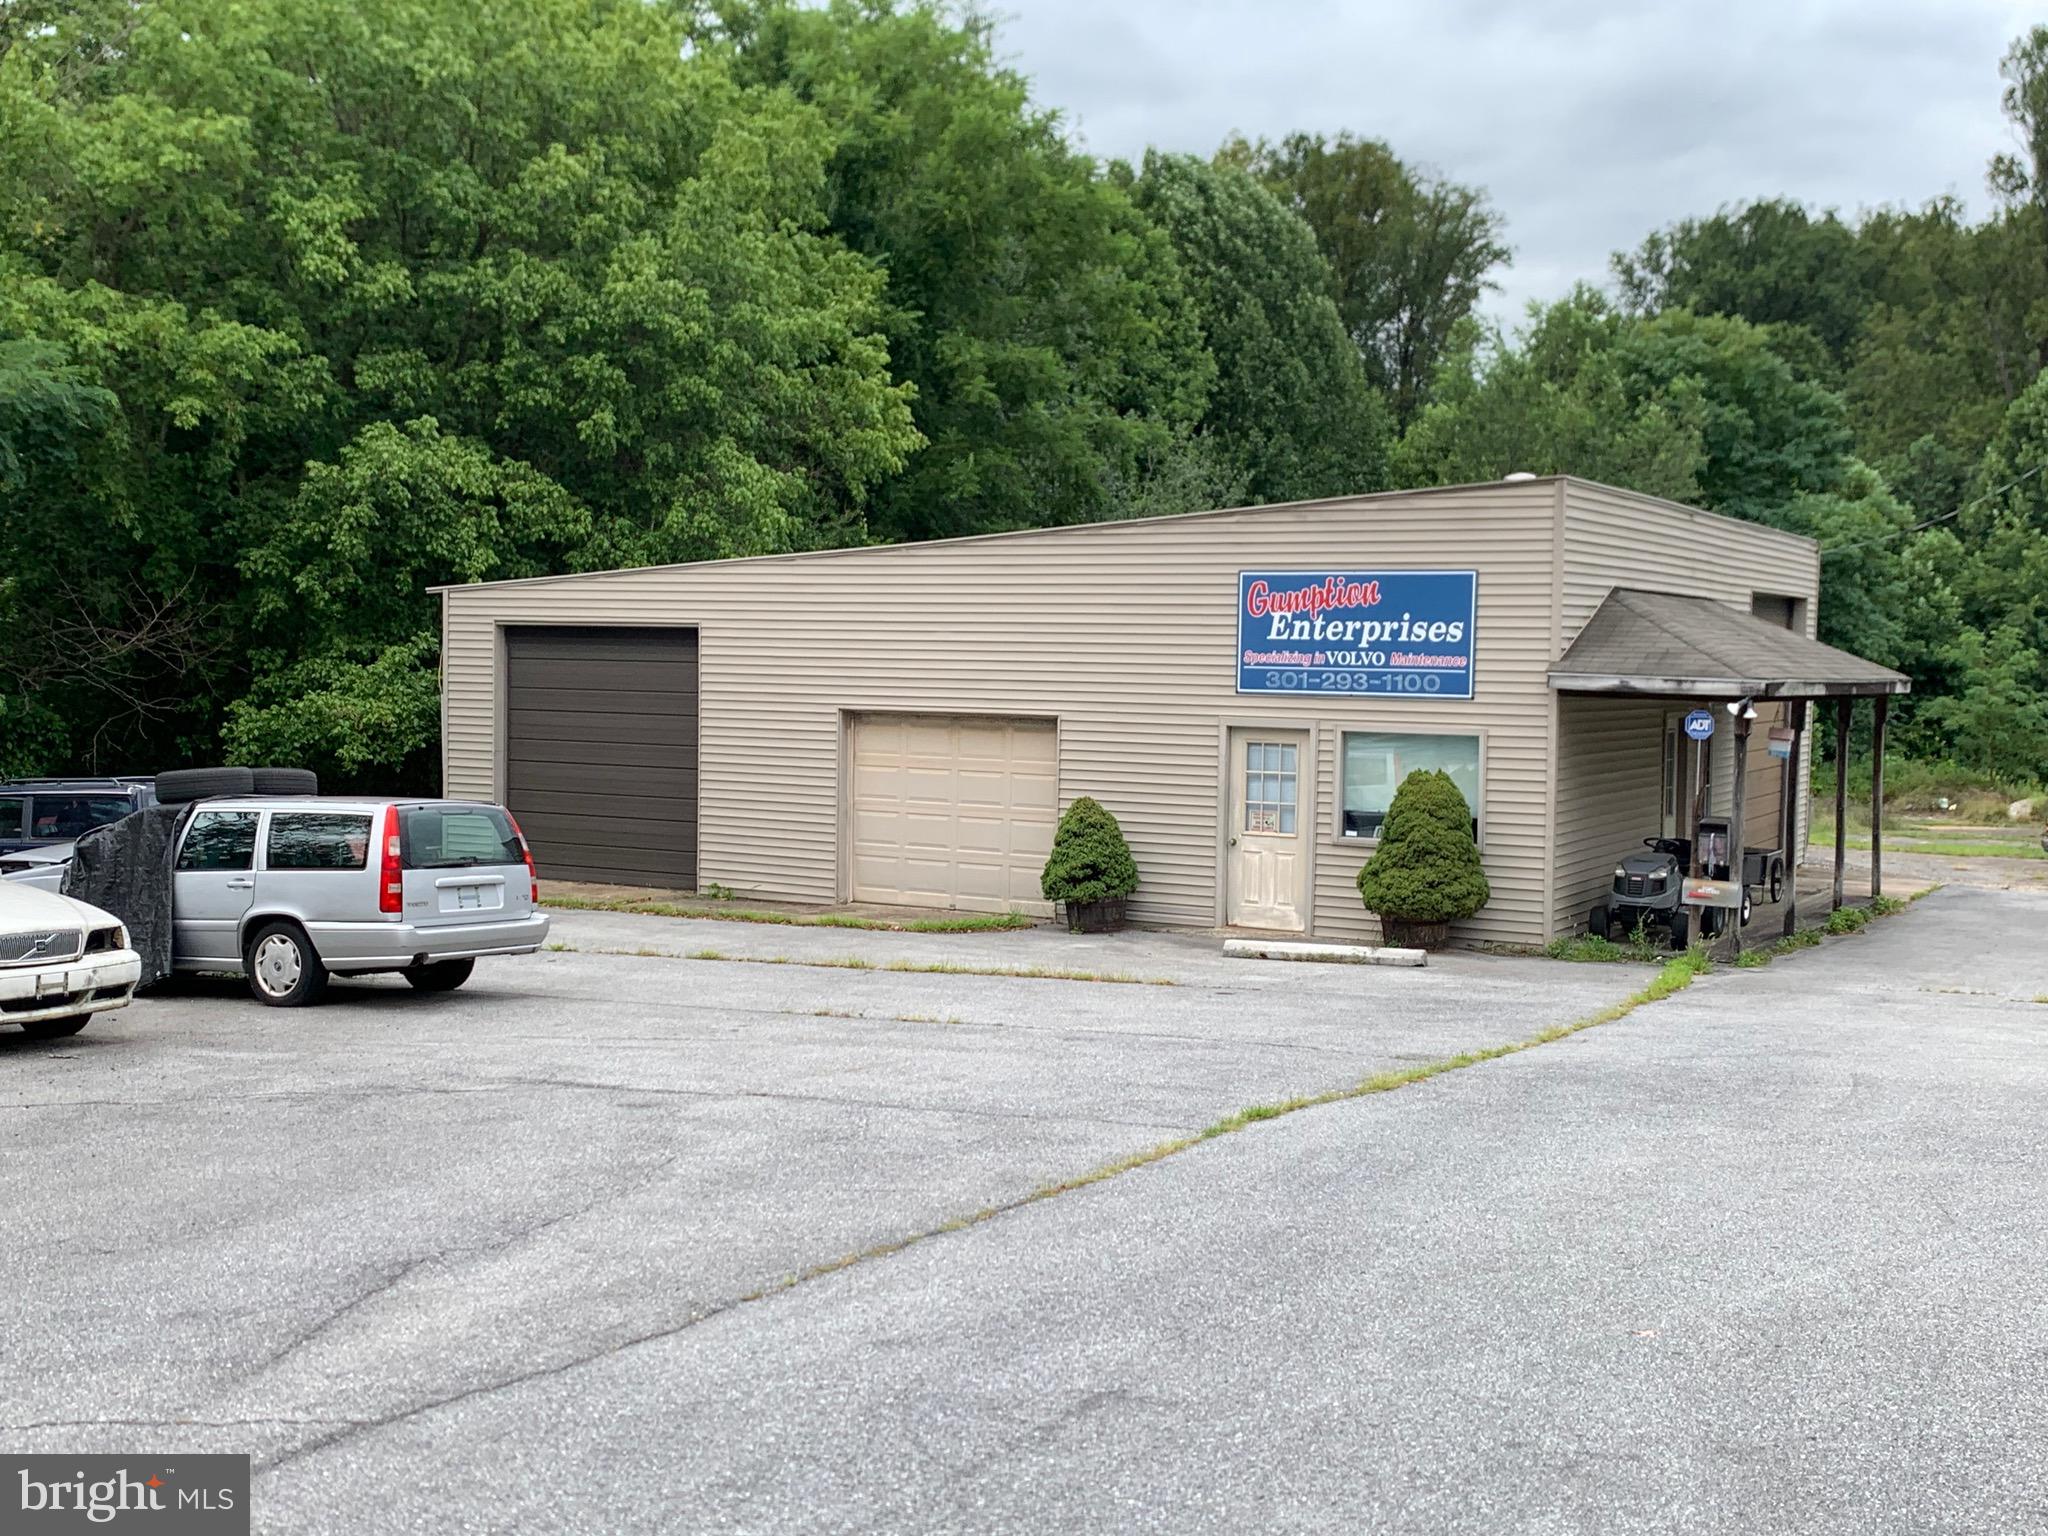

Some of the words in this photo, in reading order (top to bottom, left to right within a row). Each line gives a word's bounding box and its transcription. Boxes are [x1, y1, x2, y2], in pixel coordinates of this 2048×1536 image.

[1248, 577, 1381, 619] Gumption
[1267, 612, 1463, 647] Enterprises
[1243, 649, 1312, 667] Specializing
[1313, 651, 1325, 665] in
[1325, 651, 1385, 666] VOLVO
[1390, 651, 1467, 667] Maintenance
[1265, 671, 1440, 692] 301-293-1100
[1690, 719, 1711, 731] ADT
